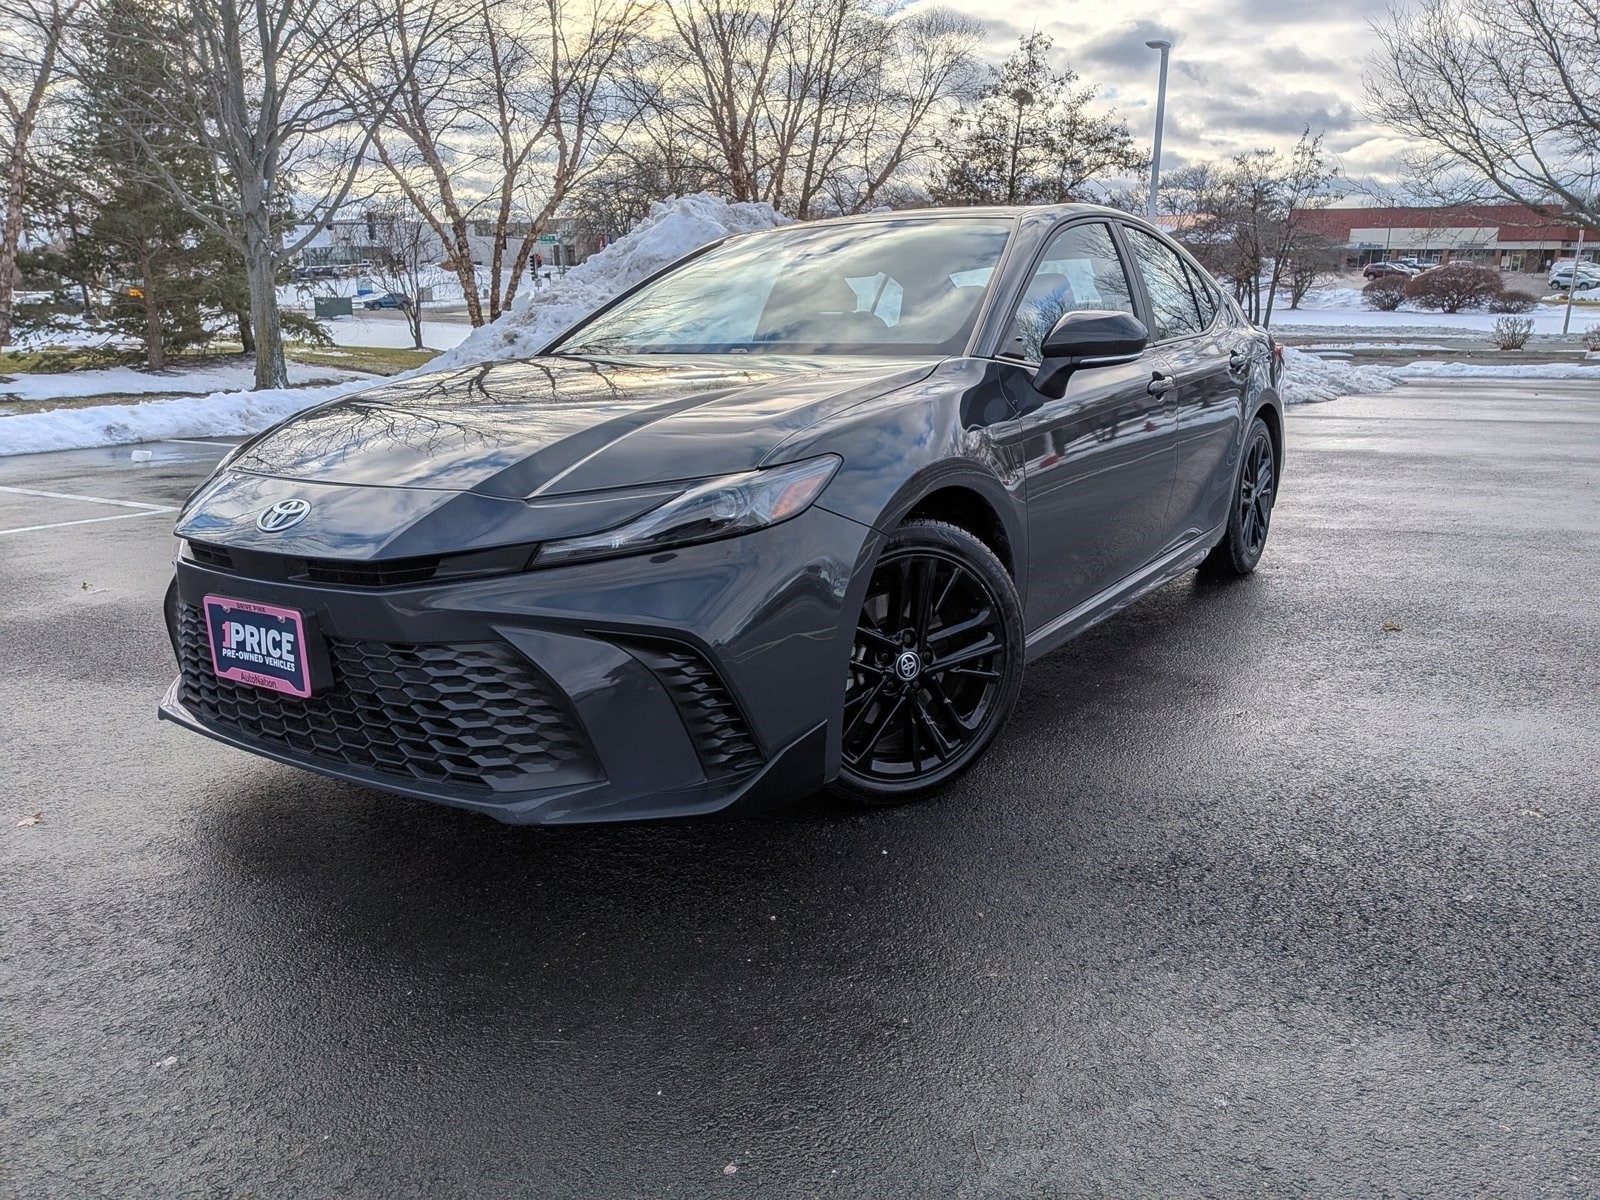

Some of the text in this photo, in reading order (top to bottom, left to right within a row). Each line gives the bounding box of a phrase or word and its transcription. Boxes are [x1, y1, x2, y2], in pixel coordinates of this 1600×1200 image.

[222, 648, 295, 672] PRE-OWNED VEHICLES
[240, 673, 276, 688] AutoNation
